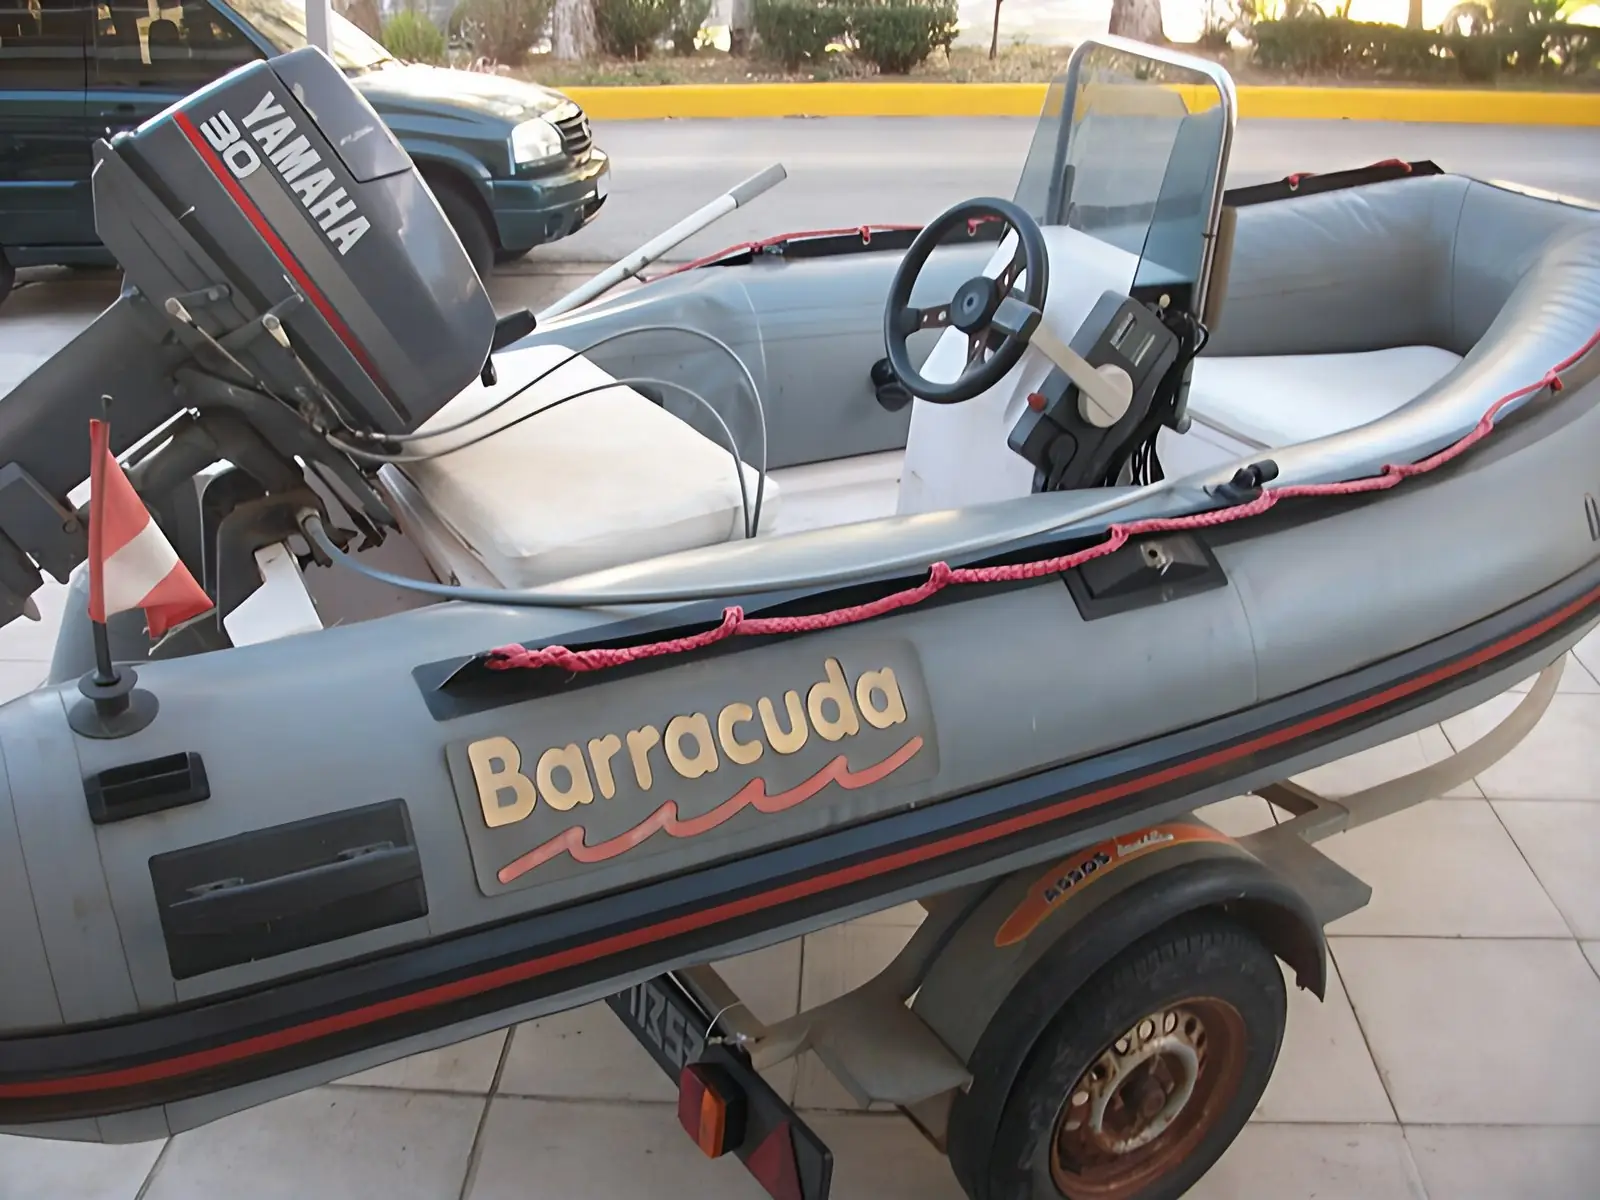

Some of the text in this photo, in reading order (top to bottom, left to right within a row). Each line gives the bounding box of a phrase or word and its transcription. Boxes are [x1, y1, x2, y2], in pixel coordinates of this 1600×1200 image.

[200, 110, 261, 179] 30
[241, 90, 371, 256] YAMAHA
[467, 657, 907, 828] Barracuda
